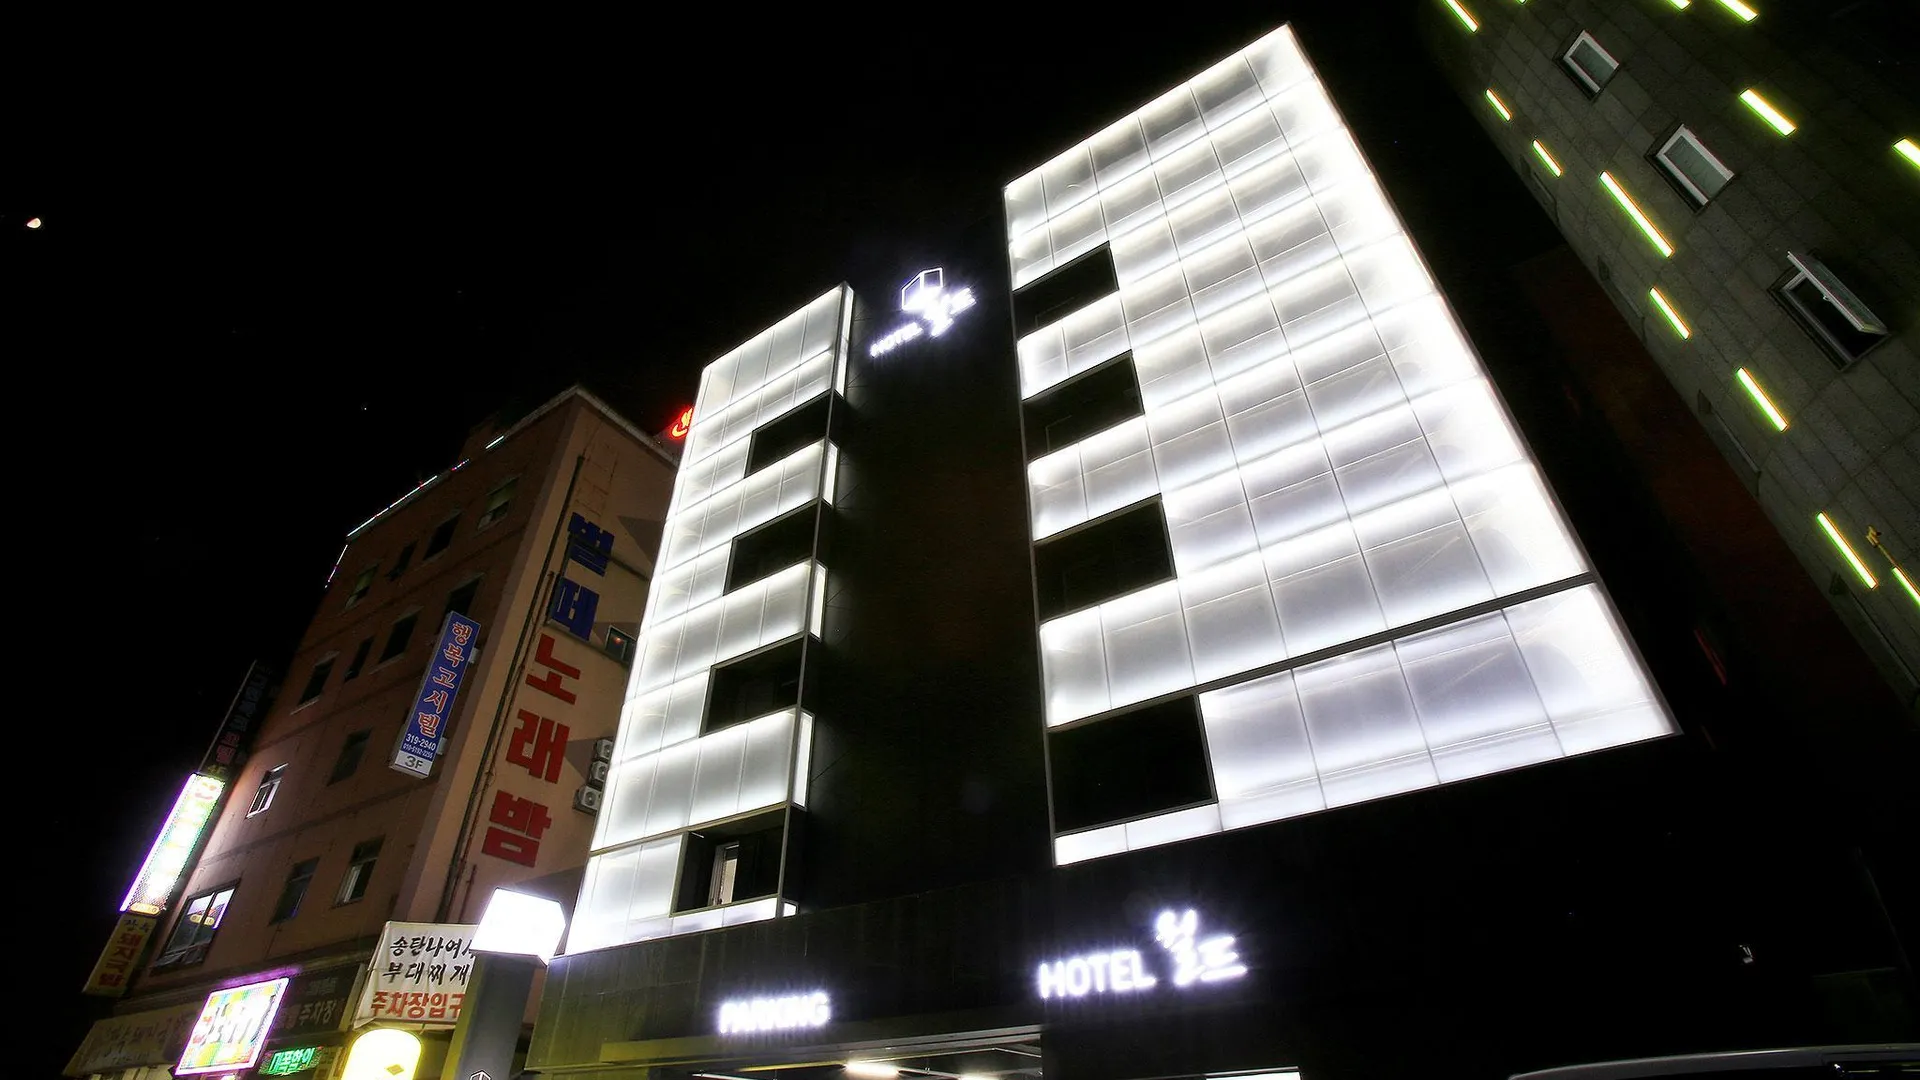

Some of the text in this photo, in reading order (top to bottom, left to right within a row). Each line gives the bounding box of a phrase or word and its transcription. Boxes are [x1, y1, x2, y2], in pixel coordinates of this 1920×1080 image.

[418, 621, 473, 739] 행복고시텔
[405, 733, 437, 751] 319-2940
[405, 755, 424, 769] 3F
[382, 962, 470, 986] 부대찌개
[1039, 949, 1157, 998] HOTEL
[371, 991, 466, 1018] 주차장입구
[717, 991, 831, 1035] PARKING
